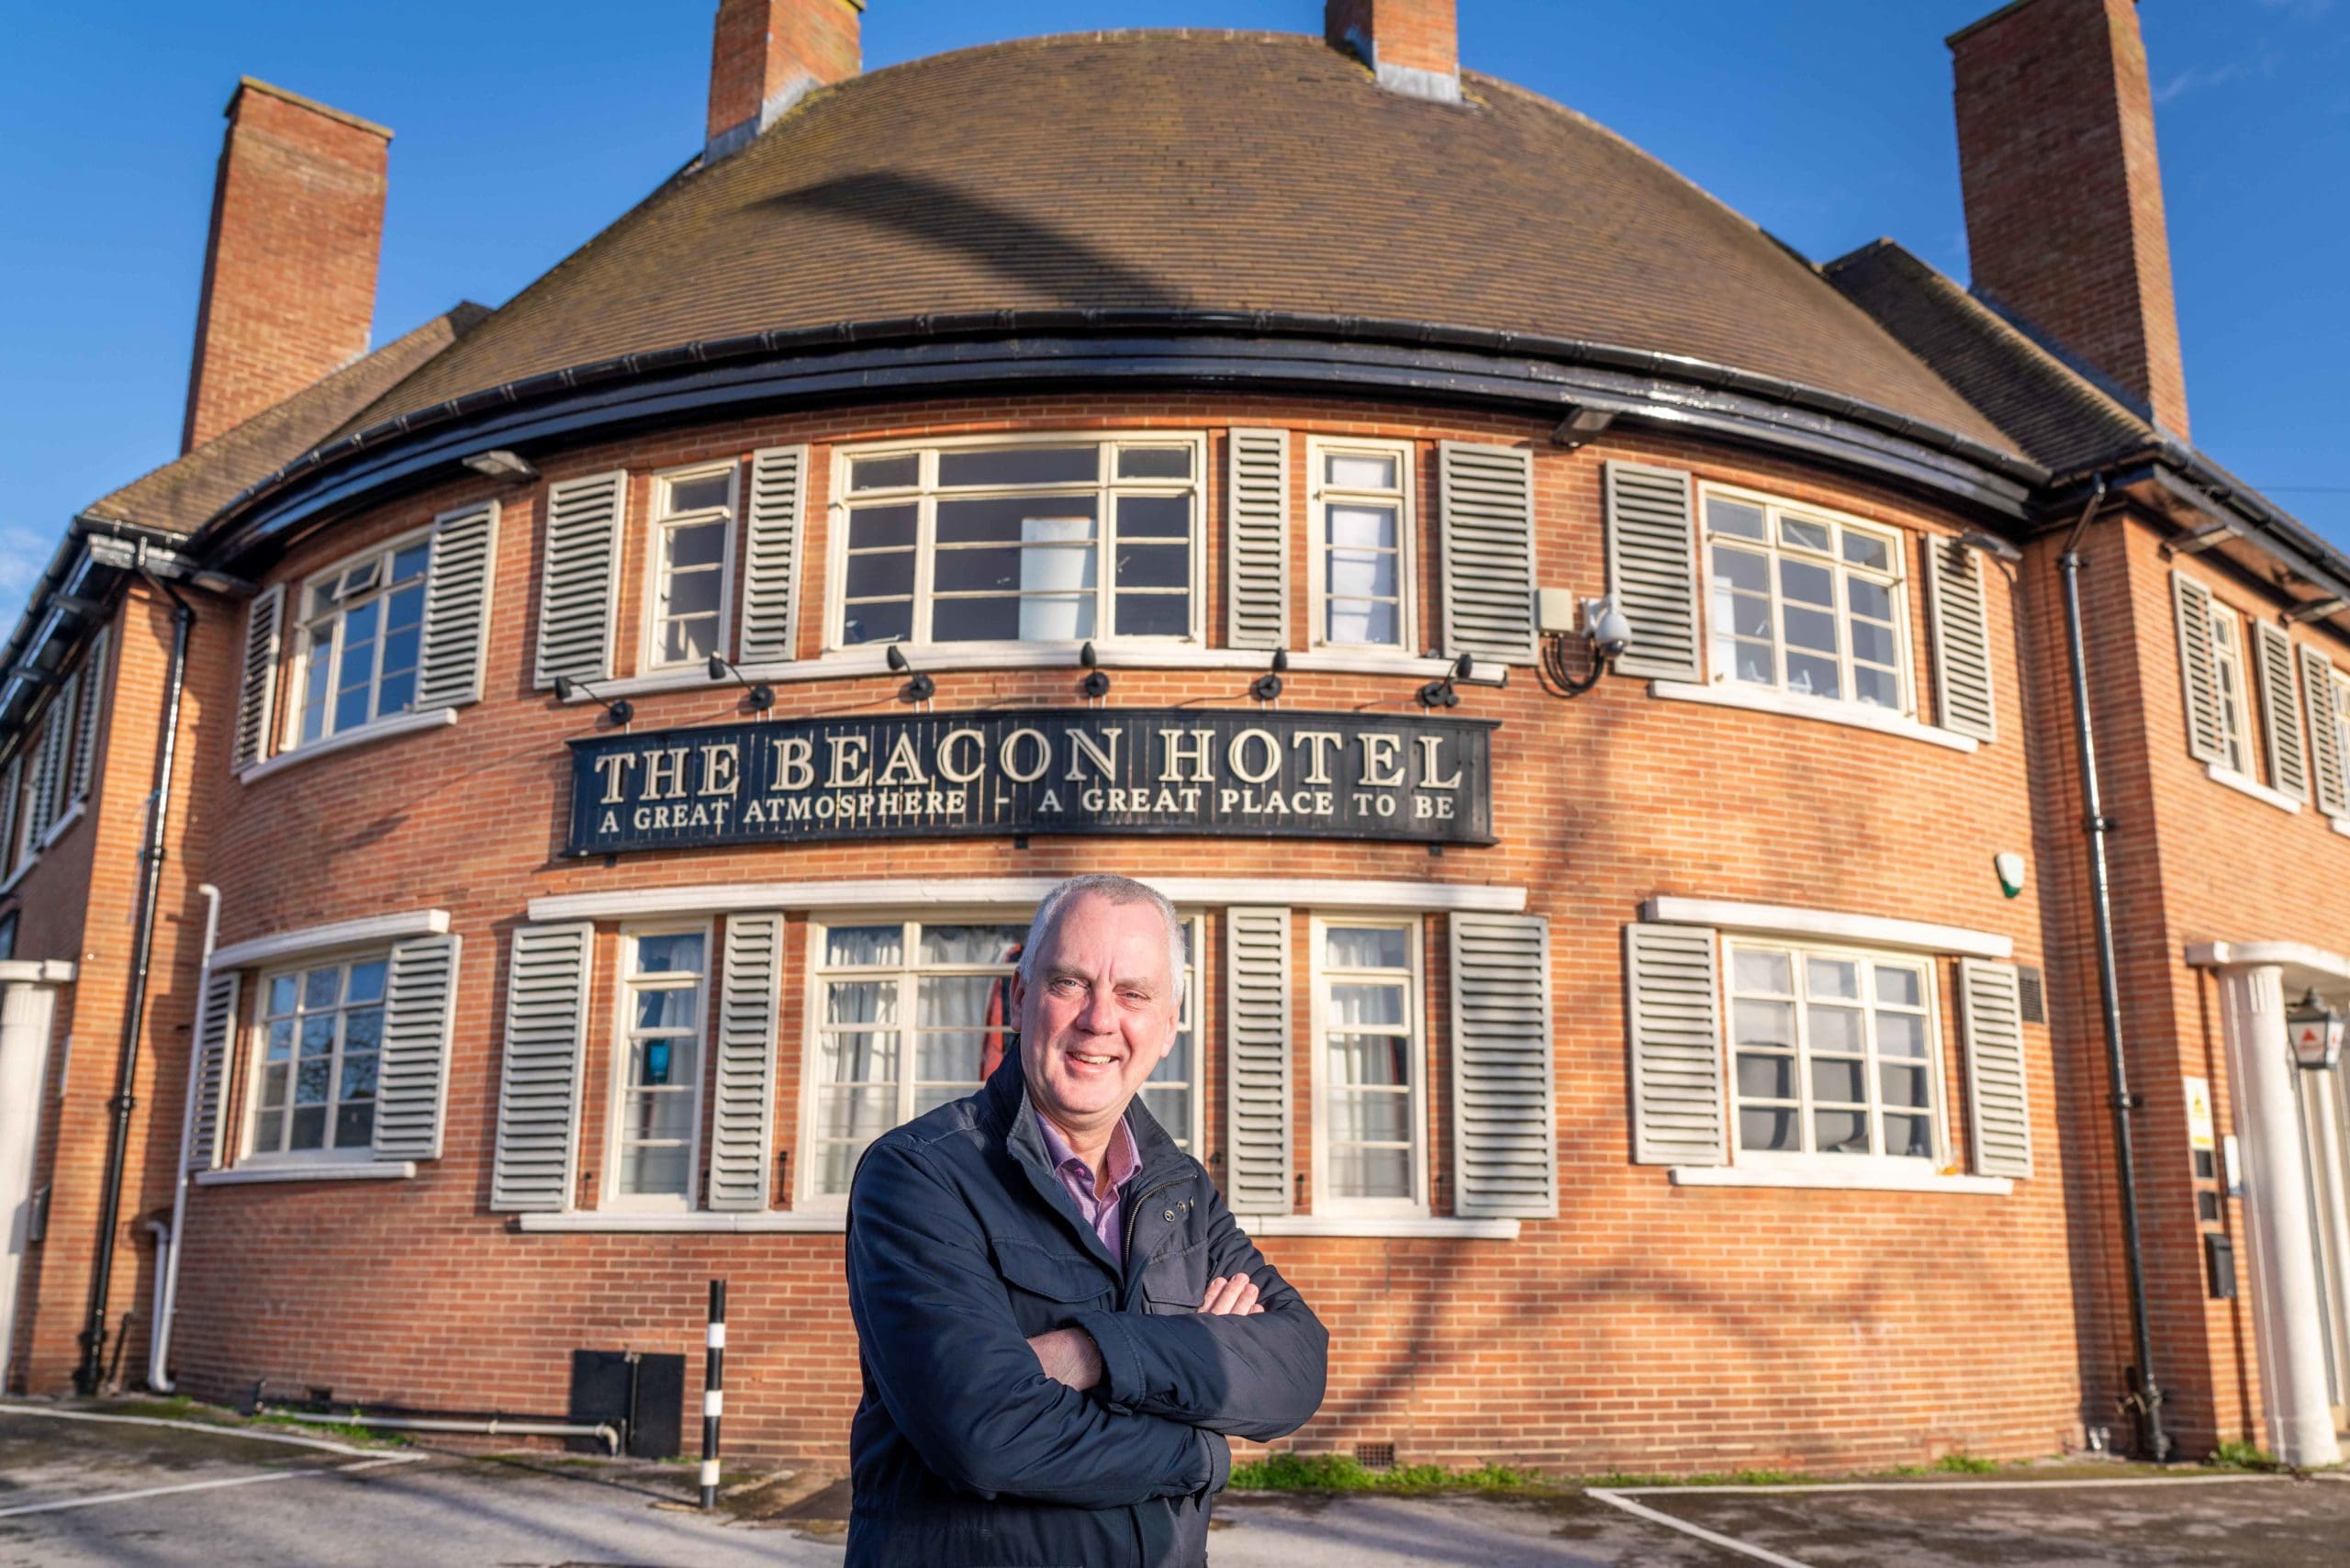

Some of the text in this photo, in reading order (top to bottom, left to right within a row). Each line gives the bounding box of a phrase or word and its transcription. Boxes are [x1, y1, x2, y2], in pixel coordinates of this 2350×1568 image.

[595, 727, 1463, 804] THE BEACON HOTEL
[599, 810, 620, 834] A
[632, 801, 730, 831] GREAT
[742, 789, 968, 823] ATMOSPHERE
[1038, 789, 1063, 813] A
[1081, 788, 1202, 813] GREAT
[1220, 790, 1334, 815] PLACE
[1352, 792, 1397, 817] TO
[1415, 796, 1455, 819] BE
